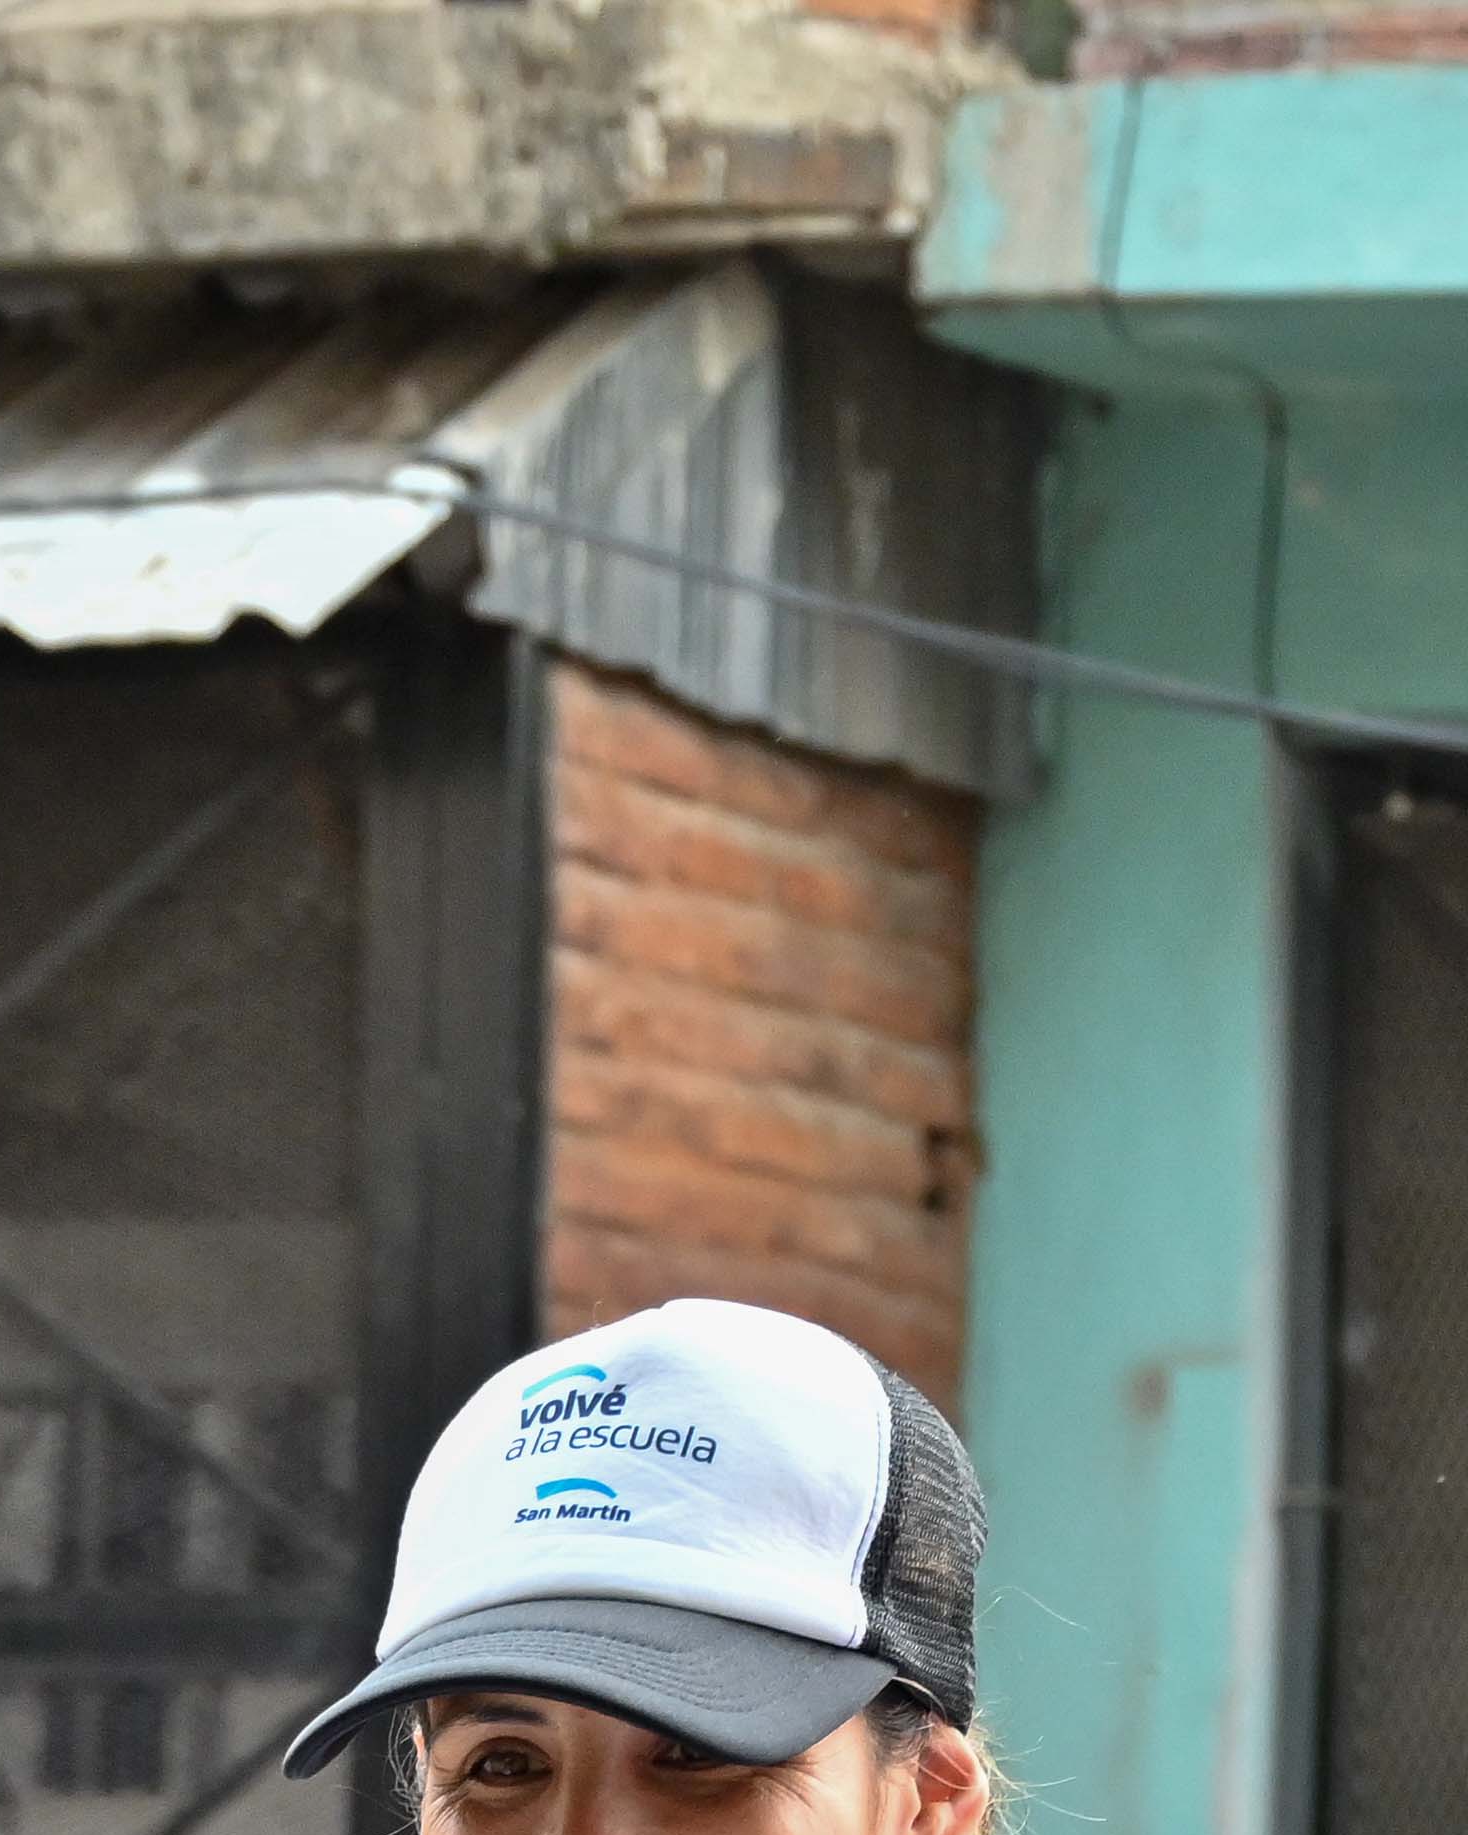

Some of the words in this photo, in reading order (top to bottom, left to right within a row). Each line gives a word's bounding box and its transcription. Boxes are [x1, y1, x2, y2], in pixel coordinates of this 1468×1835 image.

[520, 1384, 628, 1430] volvé
[505, 1437, 527, 1461] a
[530, 1427, 562, 1456] la
[568, 1424, 718, 1464] escuela
[514, 1507, 551, 1524] San
[556, 1503, 631, 1523] Martín
